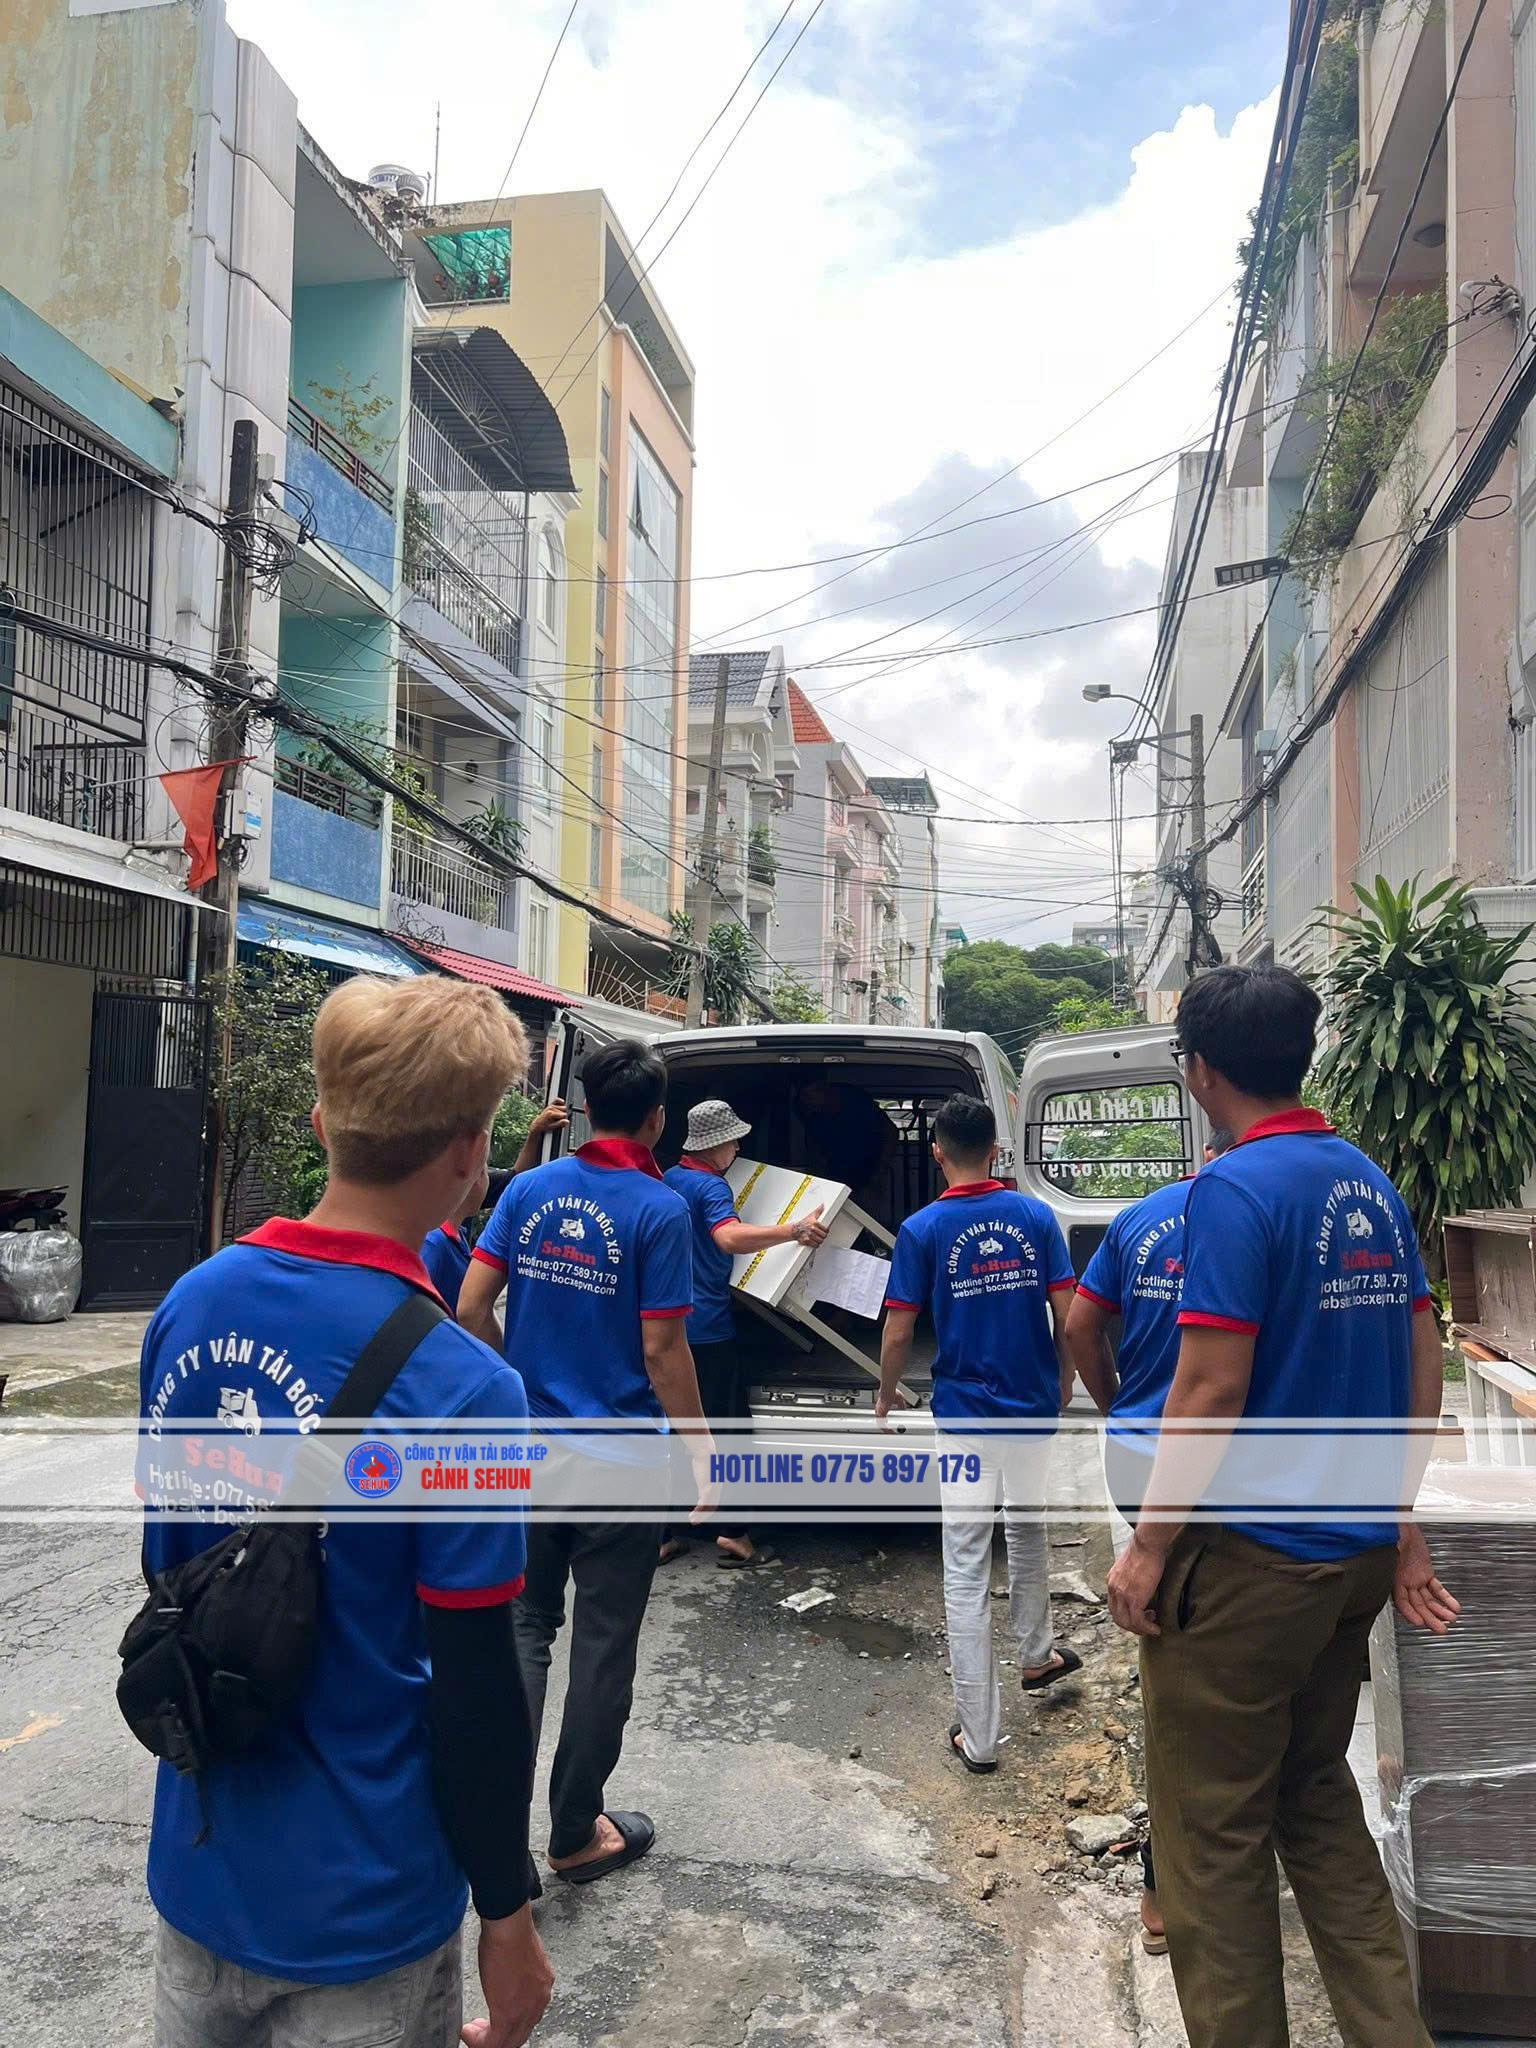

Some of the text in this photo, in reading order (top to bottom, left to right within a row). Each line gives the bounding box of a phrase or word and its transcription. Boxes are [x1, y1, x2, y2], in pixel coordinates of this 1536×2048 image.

[519, 1212, 541, 1245] CÔNG
[540, 1200, 554, 1216] TY
[558, 1194, 582, 1210] VẬN
[595, 1212, 614, 1237] BỐC
[606, 1239, 623, 1264] XẾP
[947, 1246, 961, 1274] CÔNG
[956, 1233, 968, 1246] TY
[966, 1223, 986, 1236] VẬN
[1006, 1224, 1025, 1242] BỐC
[1136, 1217, 1176, 1265] CÔNG TY
[1316, 1215, 1334, 1265] CÔNG
[1326, 1193, 1338, 1215] TY
[149, 1332, 324, 1442] CÔNG TY VẬN TẢI BỐC
